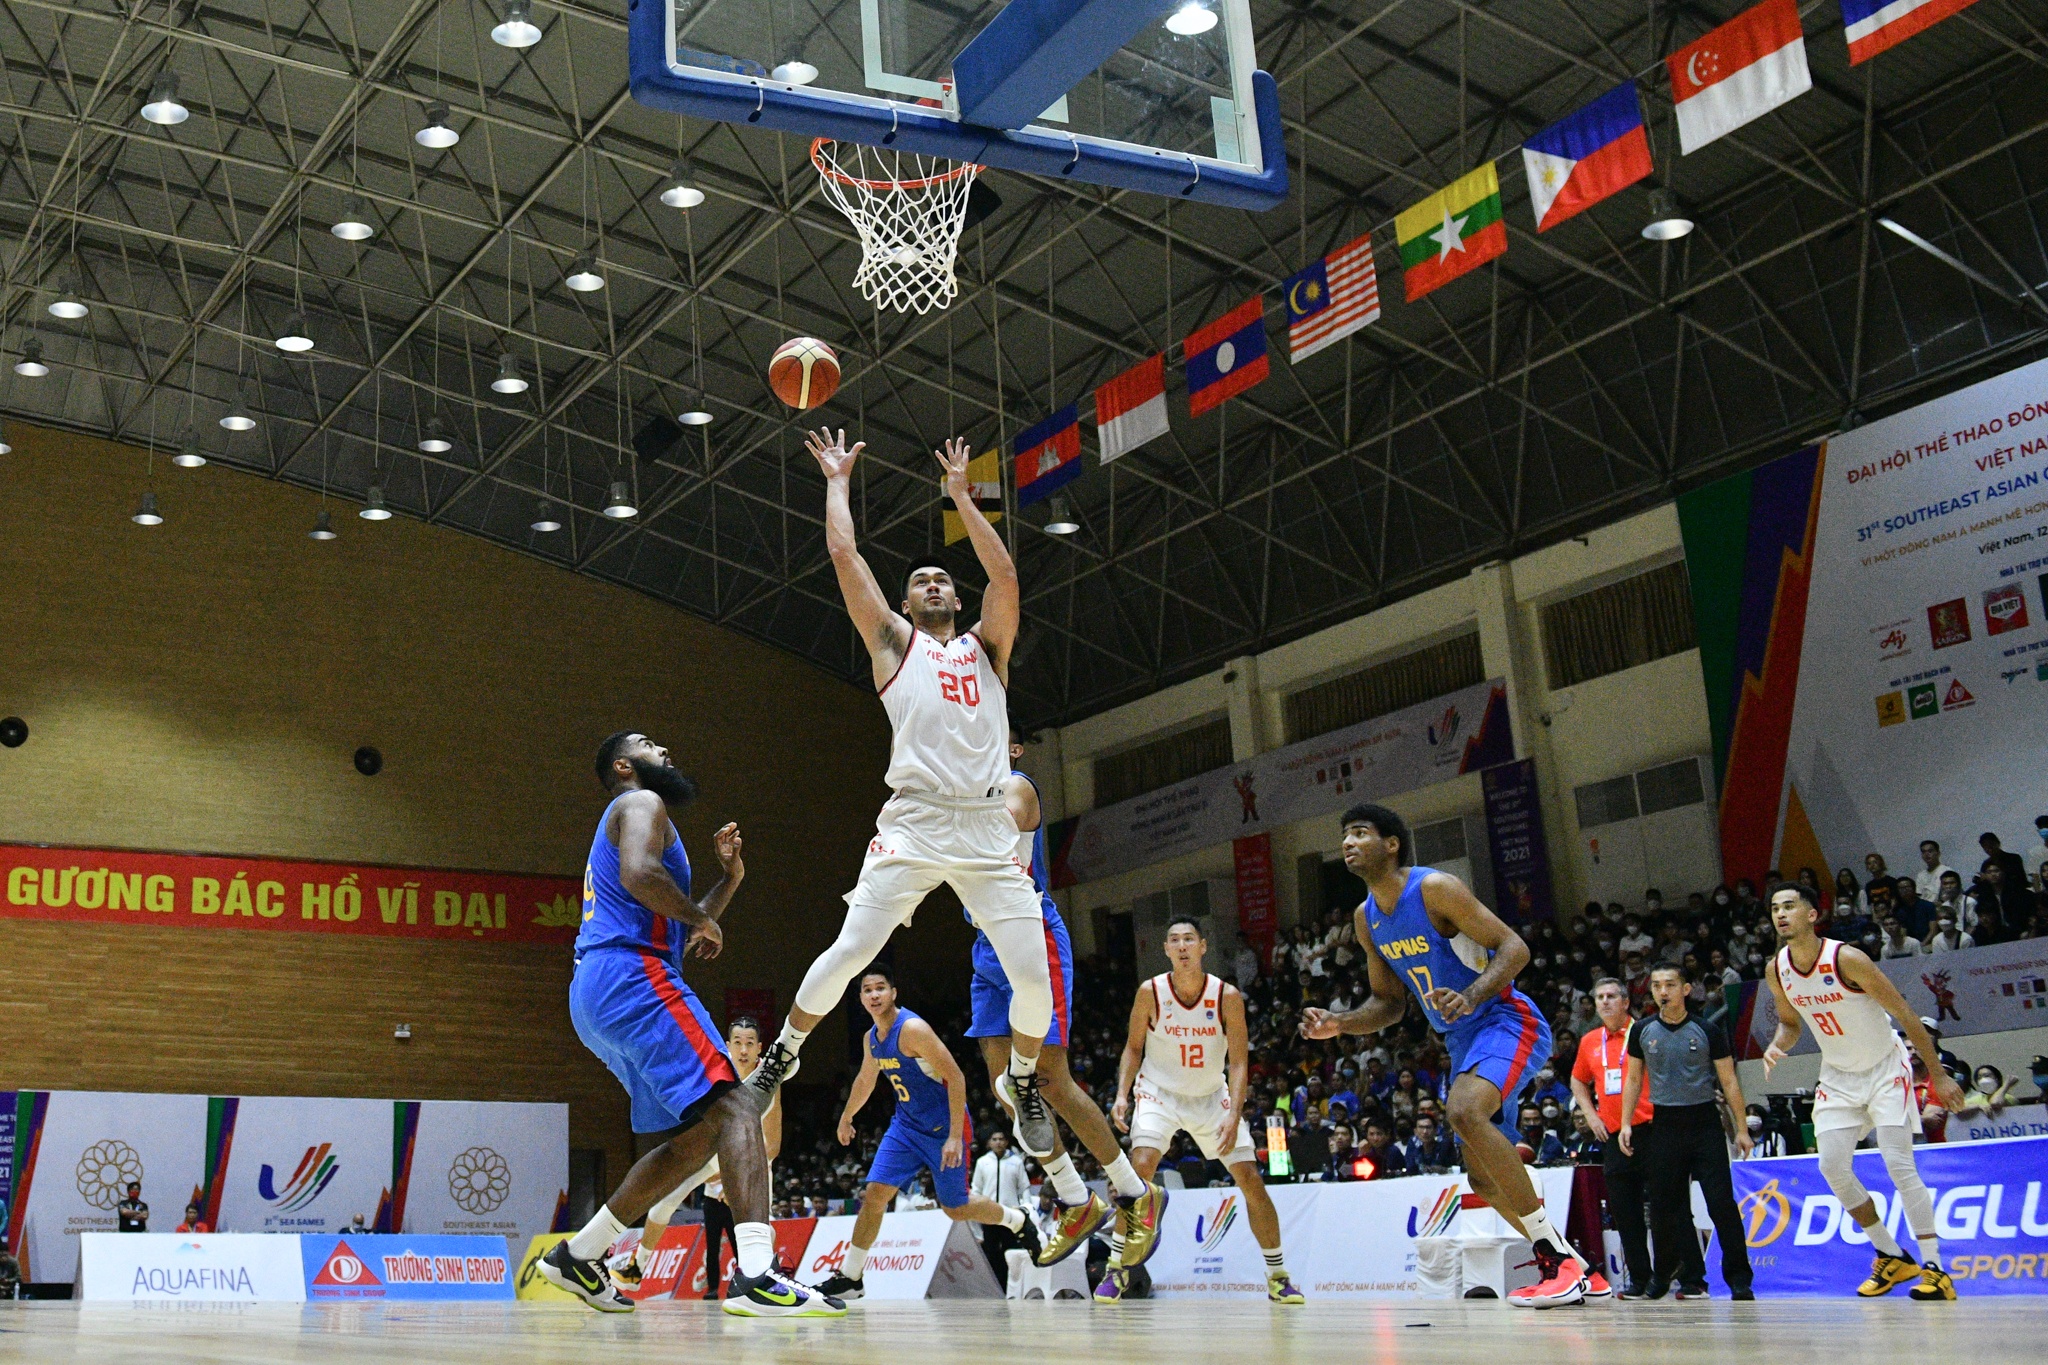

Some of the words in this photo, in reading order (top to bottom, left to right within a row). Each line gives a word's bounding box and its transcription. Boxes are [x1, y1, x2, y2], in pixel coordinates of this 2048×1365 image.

[1847, 462, 1876, 484] ĐẠI
[1881, 449, 1912, 472] HỘI
[1914, 431, 1949, 459] THỂ
[1953, 418, 2003, 446] THAO
[1975, 447, 2015, 472] VIỆT
[2020, 437, 2048, 458] NA
[1884, 489, 1980, 534] SOUTHEAST
[1985, 471, 2039, 500] ASIAN
[1932, 530, 1958, 545] NAM
[938, 670, 980, 707] 20
[1503, 846, 1530, 862] 2021
[7, 865, 175, 912] GƯƠNG
[191, 872, 285, 918] BÁC
[301, 873, 363, 922] HỒ
[378, 882, 419, 925] VĨ
[432, 890, 507, 936] ĐẠI
[1406, 965, 1438, 1010] 17
[1814, 992, 1844, 1005] NAM
[1164, 1024, 1189, 1038] VIỆT
[1192, 1026, 1217, 1036] NAM
[1811, 1011, 1845, 1036] 81
[1179, 1044, 1204, 1068] 12
[279, 1218, 295, 1226] SEA
[297, 1218, 325, 1226] GAMES
[443, 1221, 491, 1229] SOUTHEAST
[383, 1251, 433, 1282] TRƯỜNG
[435, 1258, 465, 1282] SINH
[466, 1257, 506, 1283] GROUP
[132, 1266, 254, 1295] AQUAFINA
[1355, 1283, 1369, 1291] NAM
[363, 1289, 386, 1297] GROUP
